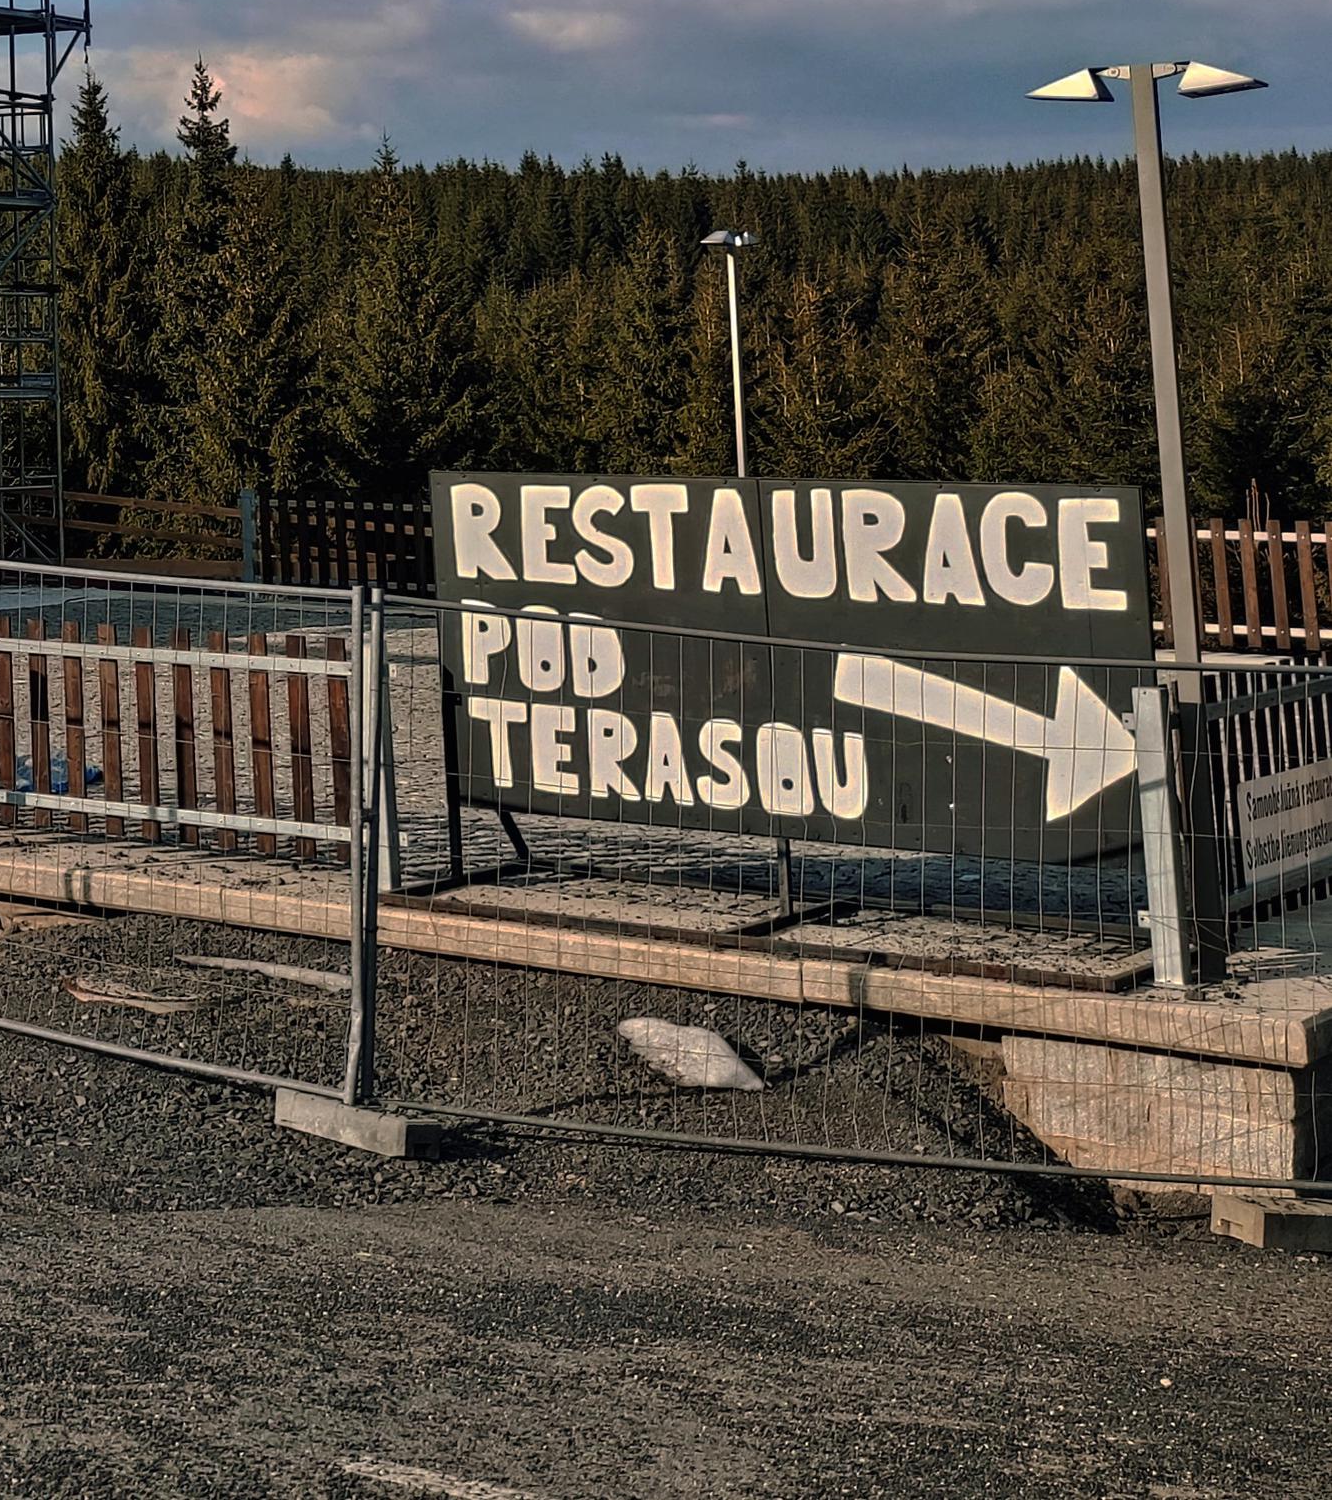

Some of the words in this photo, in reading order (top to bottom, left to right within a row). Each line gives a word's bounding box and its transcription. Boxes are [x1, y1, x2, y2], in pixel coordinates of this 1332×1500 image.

[449, 482, 1128, 611] RESTAURACE
[460, 599, 627, 698] POD
[468, 696, 869, 820] TERASOU
